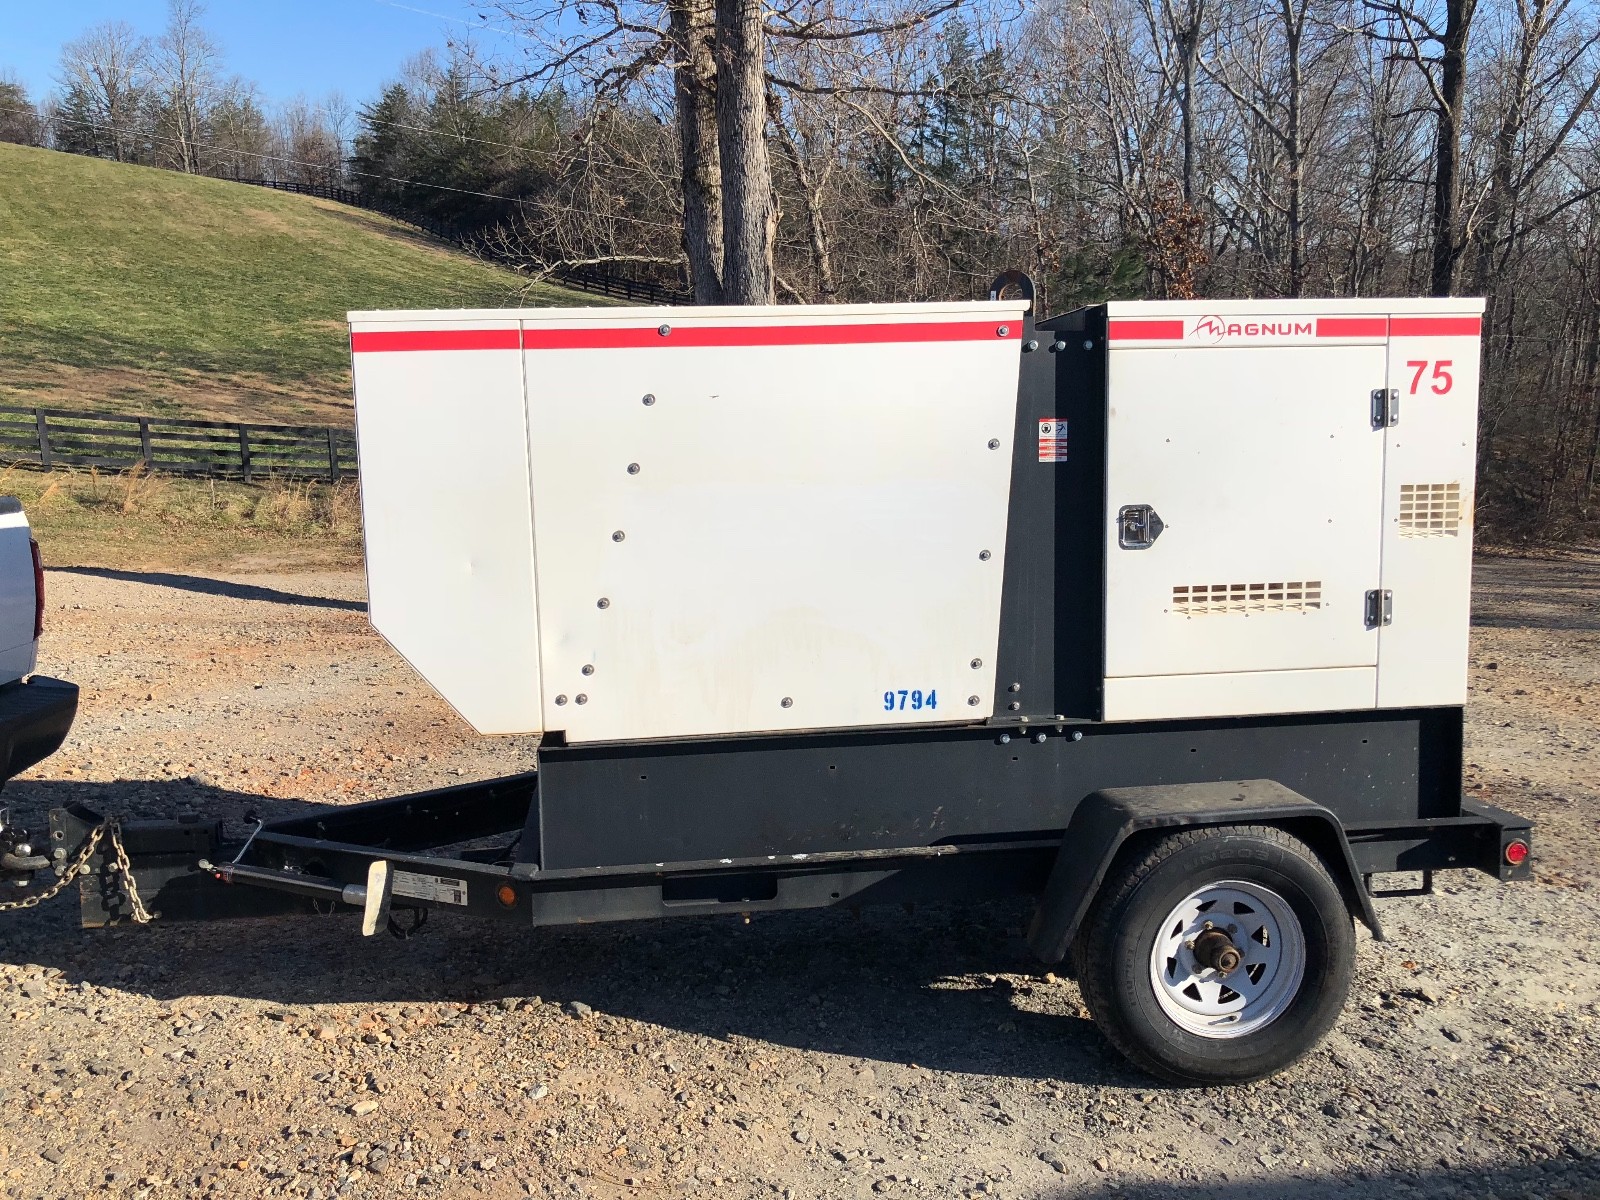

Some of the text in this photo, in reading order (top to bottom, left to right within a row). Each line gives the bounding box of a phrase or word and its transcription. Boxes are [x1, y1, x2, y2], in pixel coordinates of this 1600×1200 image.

[1189, 316, 1312, 341] MAGNUM
[1406, 359, 1453, 396] 75
[883, 689, 937, 711] 9794
